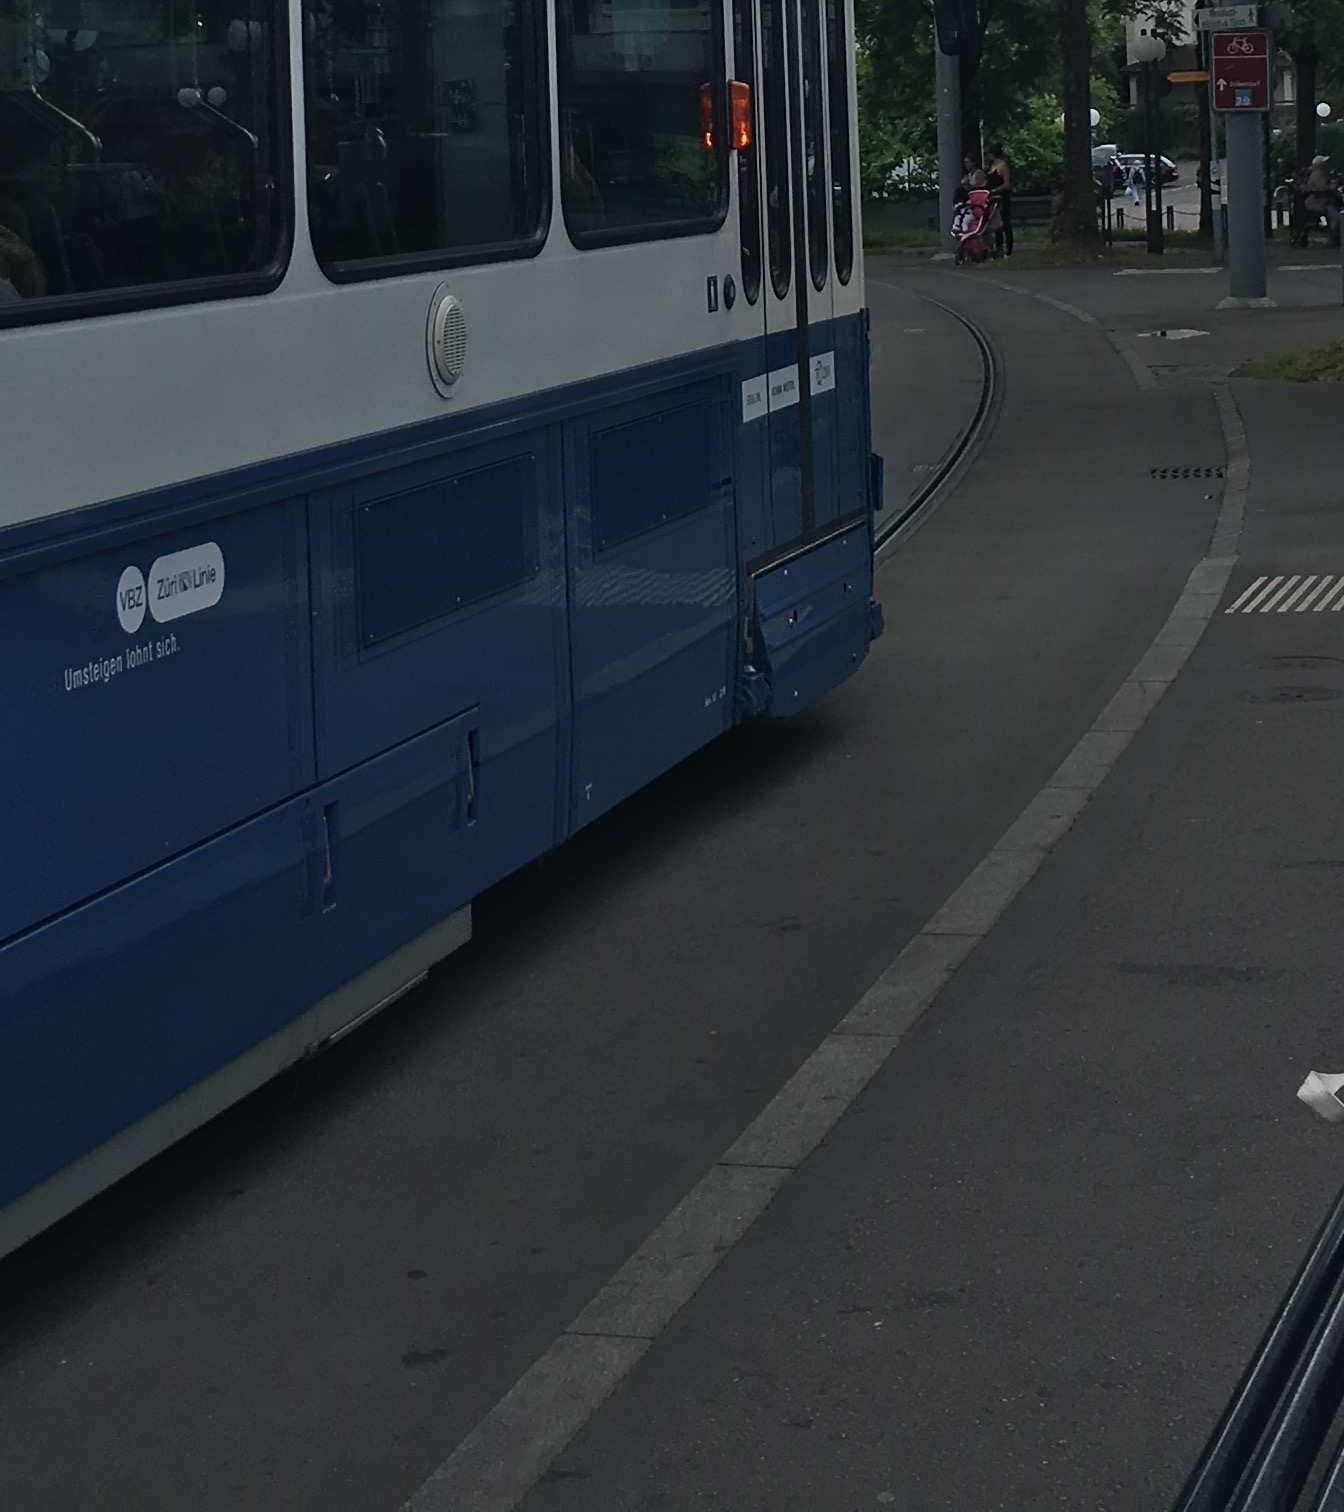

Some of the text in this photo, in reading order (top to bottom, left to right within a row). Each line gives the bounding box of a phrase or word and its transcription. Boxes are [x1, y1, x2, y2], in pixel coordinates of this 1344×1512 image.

[119, 584, 143, 612] VBZ
[156, 564, 217, 601] Züri Linie
[64, 632, 181, 691] Umsteigen lohnt sich.
